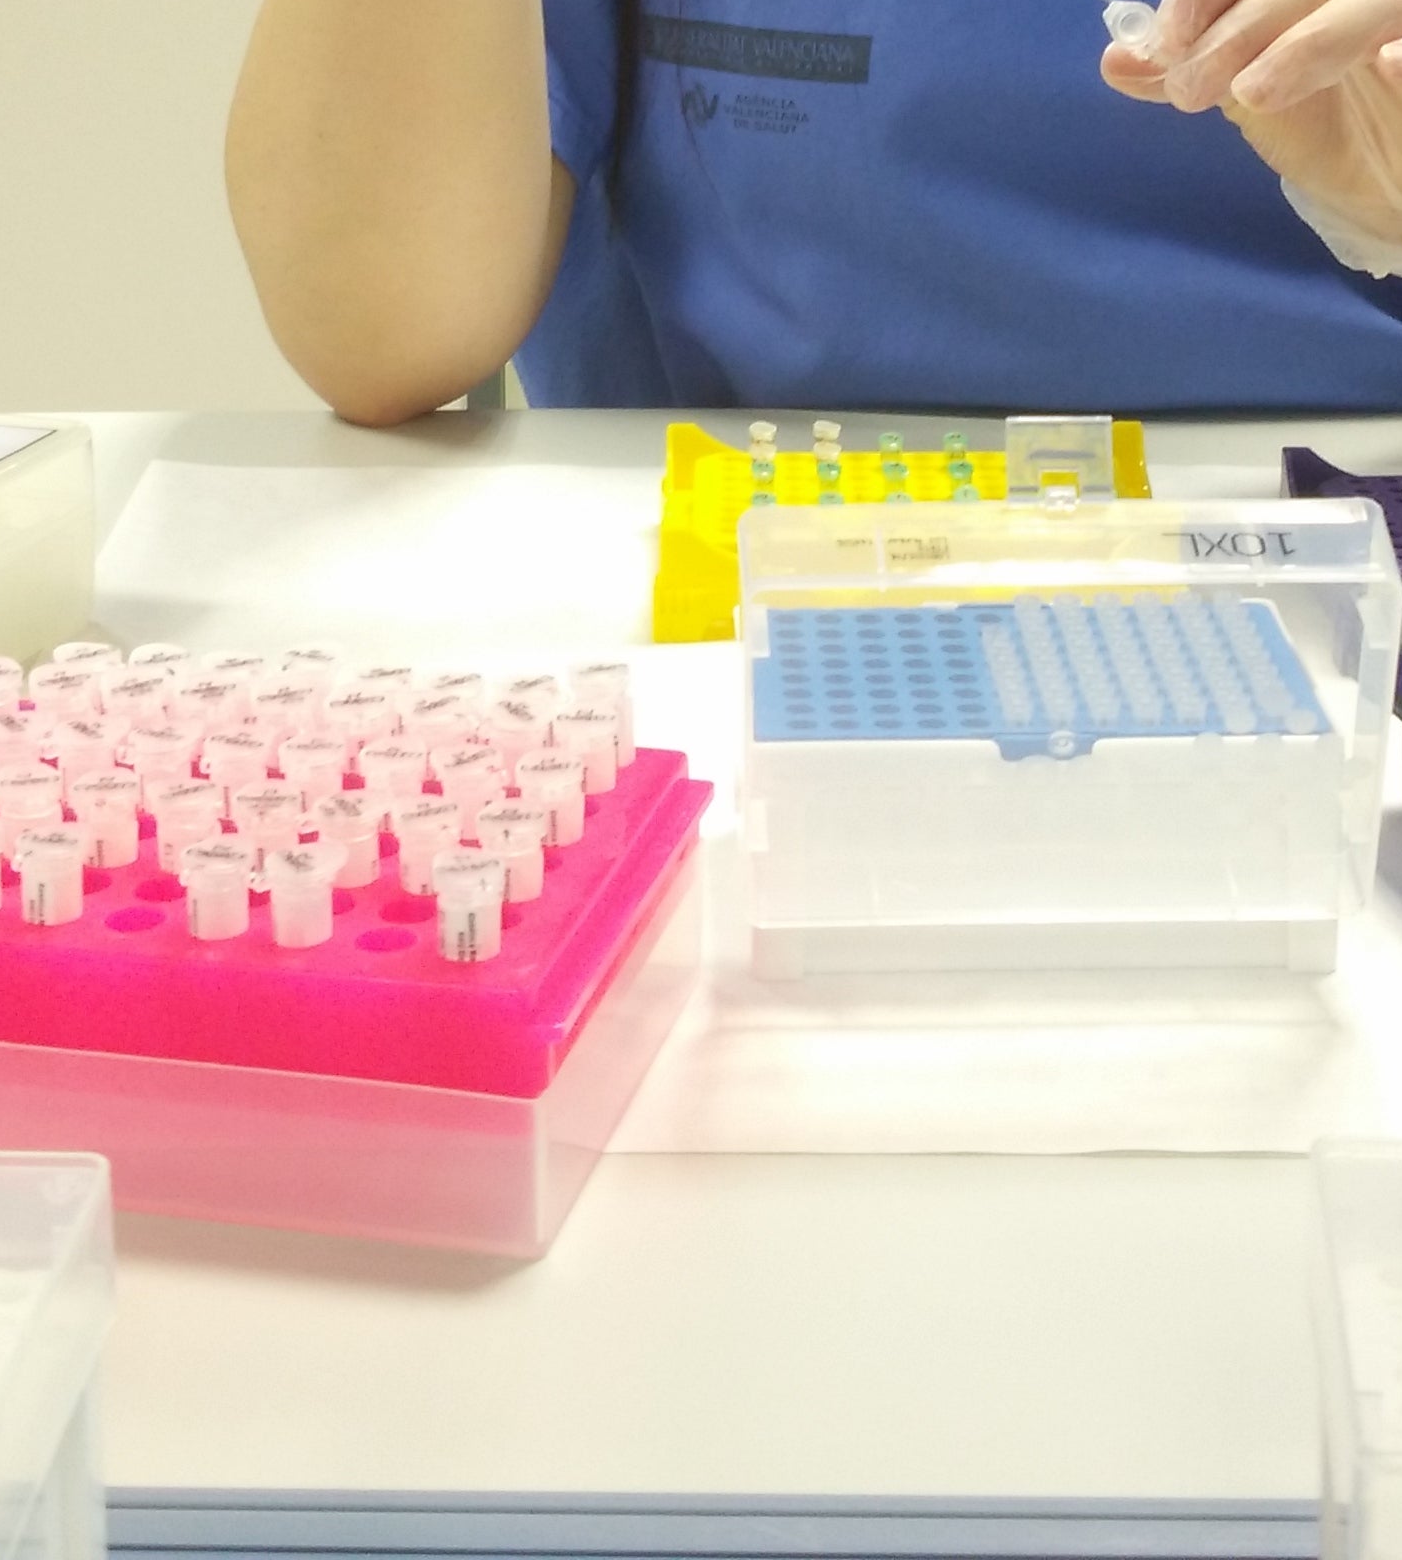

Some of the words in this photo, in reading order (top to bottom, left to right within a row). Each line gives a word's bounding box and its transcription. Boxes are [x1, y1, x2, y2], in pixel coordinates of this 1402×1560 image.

[754, 37, 856, 64] VALENCIANA
[724, 104, 810, 123] VALENCIANA
[733, 118, 751, 129] DE
[754, 120, 798, 135] SALUT
